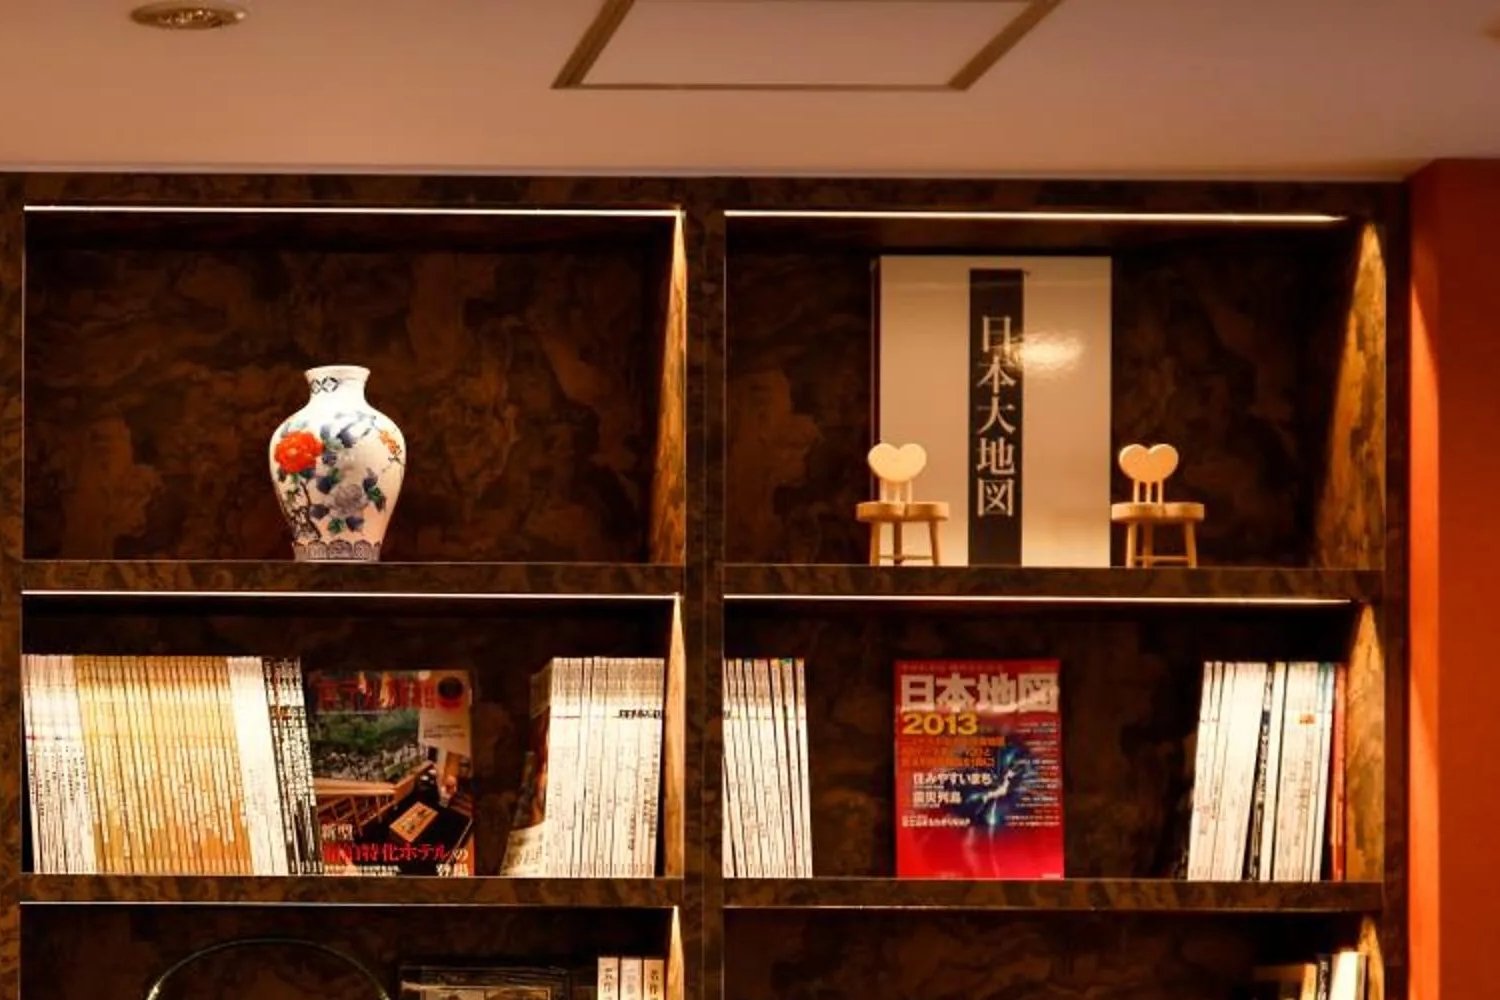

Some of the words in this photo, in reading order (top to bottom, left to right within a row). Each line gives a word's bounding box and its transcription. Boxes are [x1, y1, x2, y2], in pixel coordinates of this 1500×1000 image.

[976, 316, 1017, 518] 日本大地図
[900, 672, 1059, 713] 日本地図
[902, 713, 979, 735] 2013
